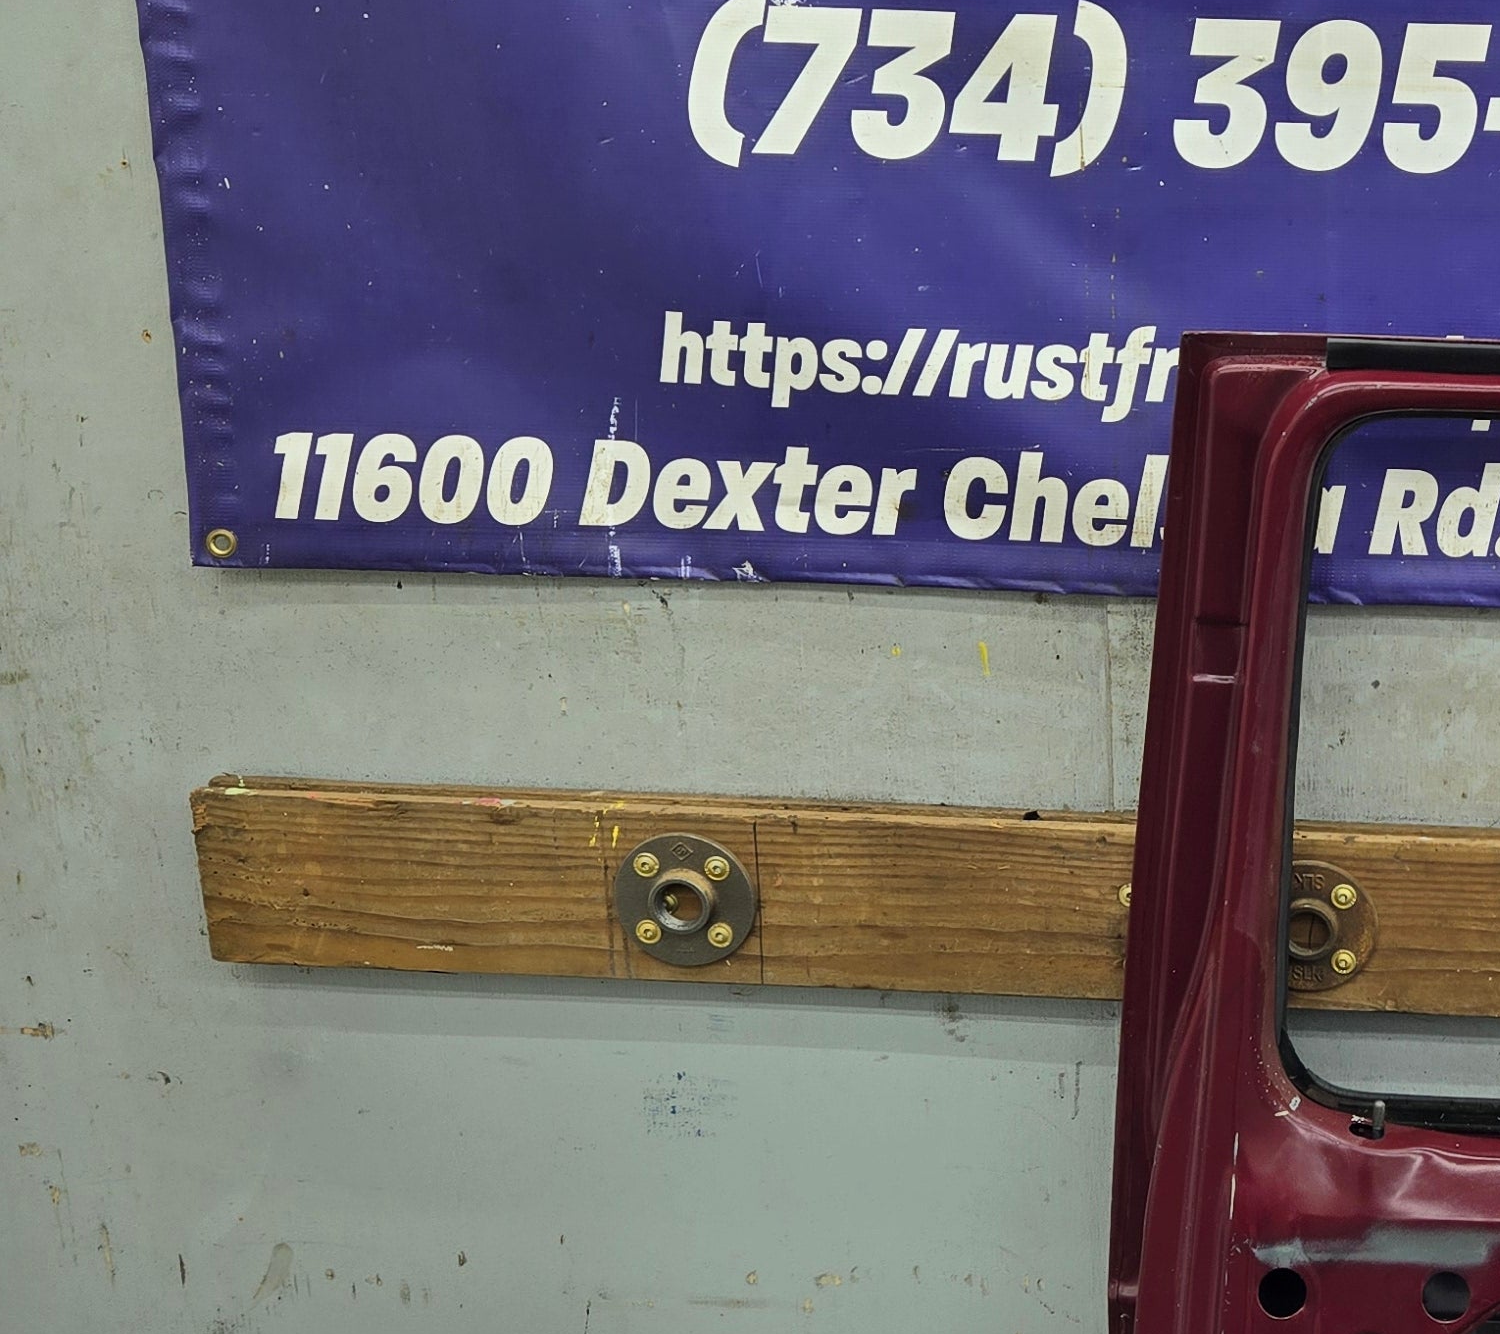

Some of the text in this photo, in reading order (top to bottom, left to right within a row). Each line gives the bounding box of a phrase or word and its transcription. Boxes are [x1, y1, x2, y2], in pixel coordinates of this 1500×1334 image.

[659, 310, 1181, 425] https://rustfr
[273, 431, 554, 526] 11600
[578, 434, 918, 536] Dexter
[943, 450, 1347, 555] Chel
